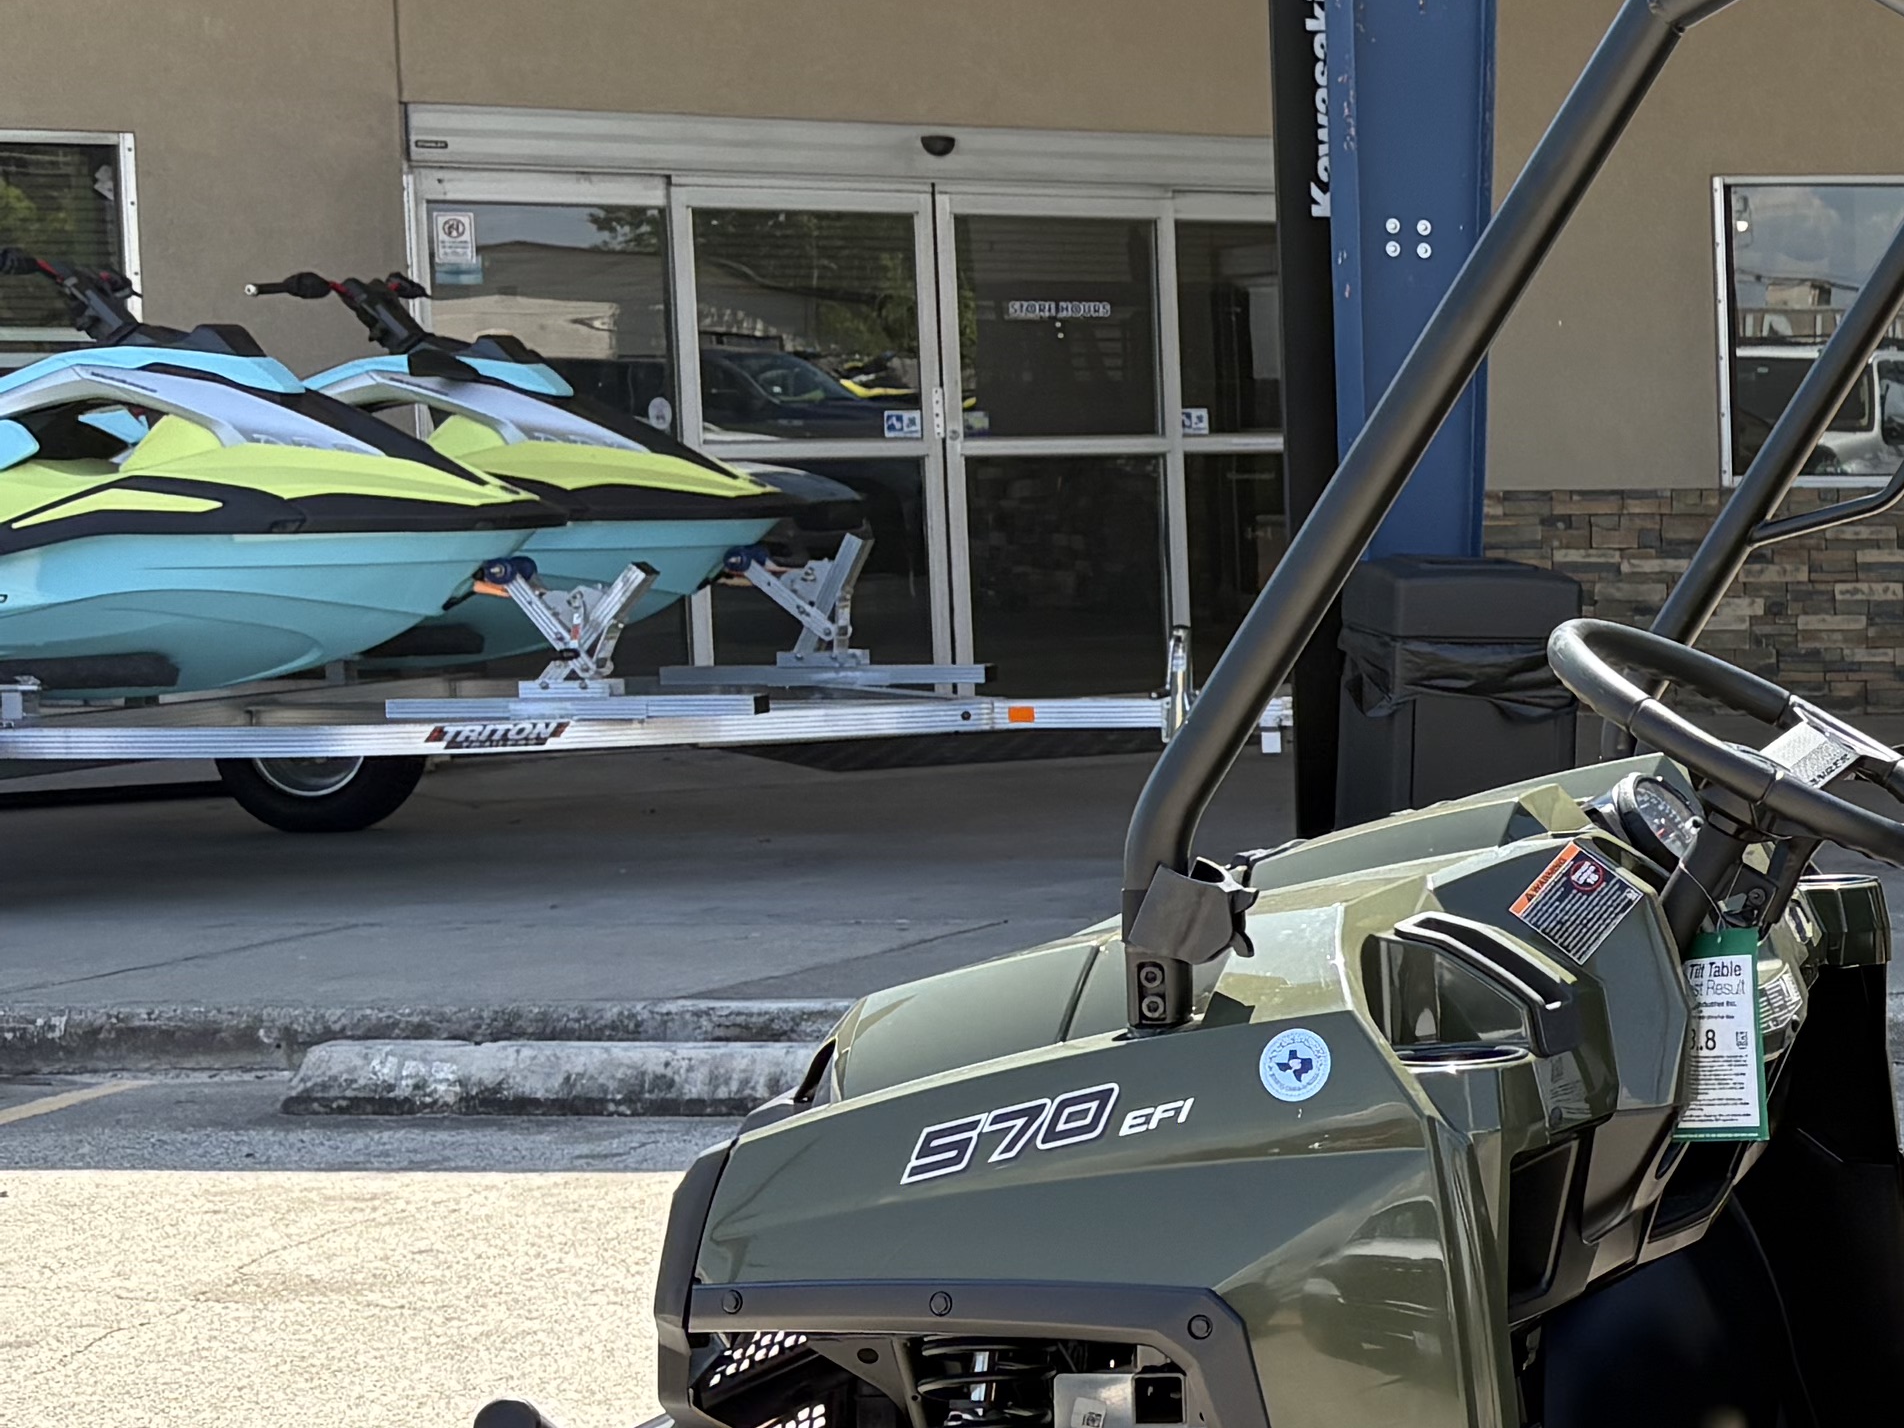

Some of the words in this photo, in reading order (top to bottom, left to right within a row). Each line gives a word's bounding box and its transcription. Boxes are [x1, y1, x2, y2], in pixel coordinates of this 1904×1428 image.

[442, 722, 557, 743] TRITON
[1709, 960, 1742, 977] Table
[1706, 978, 1745, 995] Result
[900, 1082, 1119, 1185] 570
[1118, 1097, 1195, 1137] EFI
